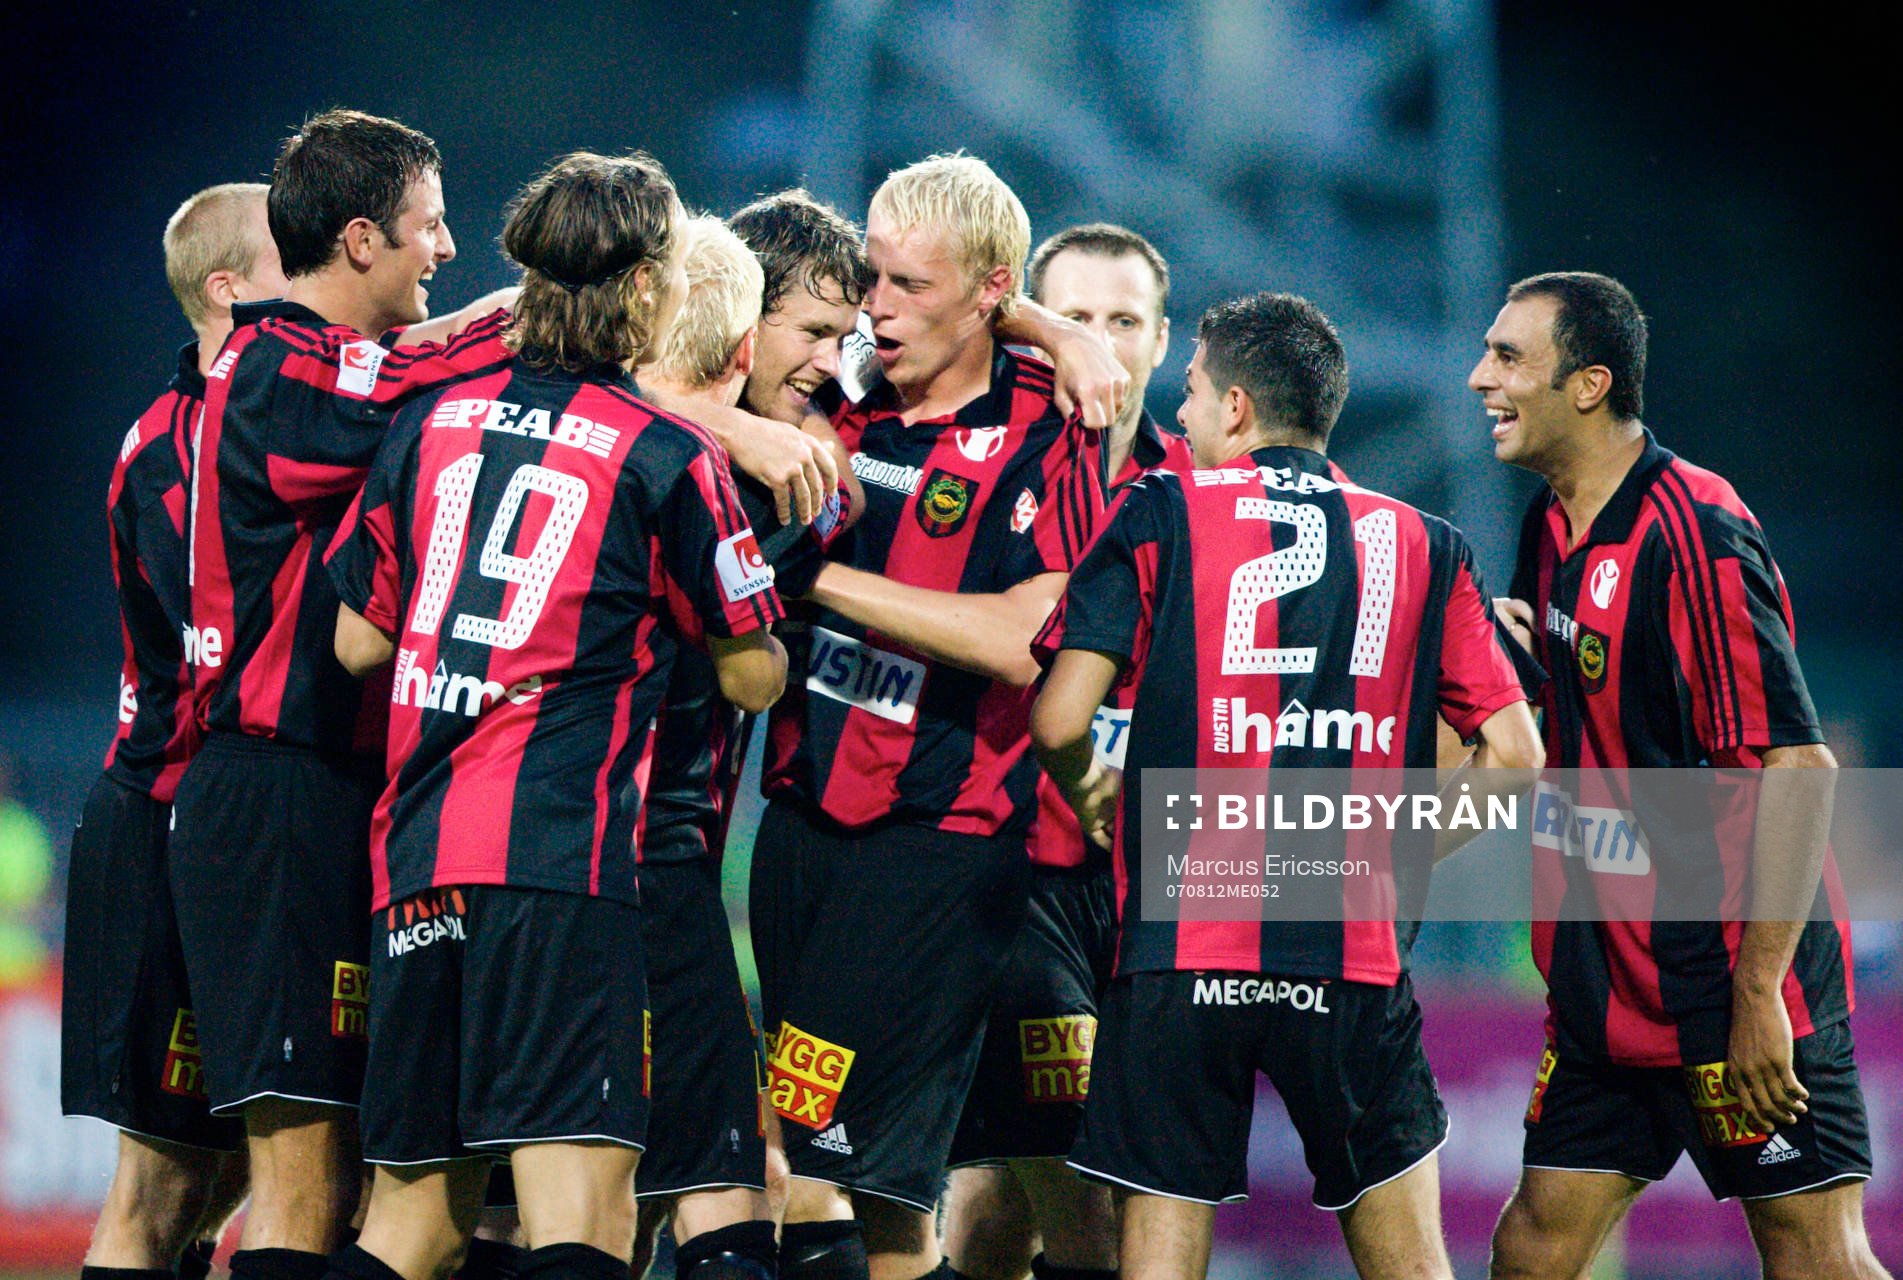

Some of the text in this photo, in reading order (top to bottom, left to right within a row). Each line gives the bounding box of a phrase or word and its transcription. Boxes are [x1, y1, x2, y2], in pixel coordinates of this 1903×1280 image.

[447, 399, 593, 449] PEAB
[850, 452, 924, 497] STADIUM
[1220, 466, 1378, 496] PEA
[411, 452, 589, 650] 19
[733, 575, 771, 596] SVENSKA
[1221, 497, 1397, 678] 21
[1213, 697, 1229, 753] DUSTIN
[1193, 978, 1330, 1014] MEGAPOL
[766, 1028, 845, 1083] YGG
[768, 1070, 827, 1122] ax
[1032, 1065, 1091, 1096] ma
[811, 1137, 853, 1155] adidas
[1758, 1149, 1801, 1165] adidas
